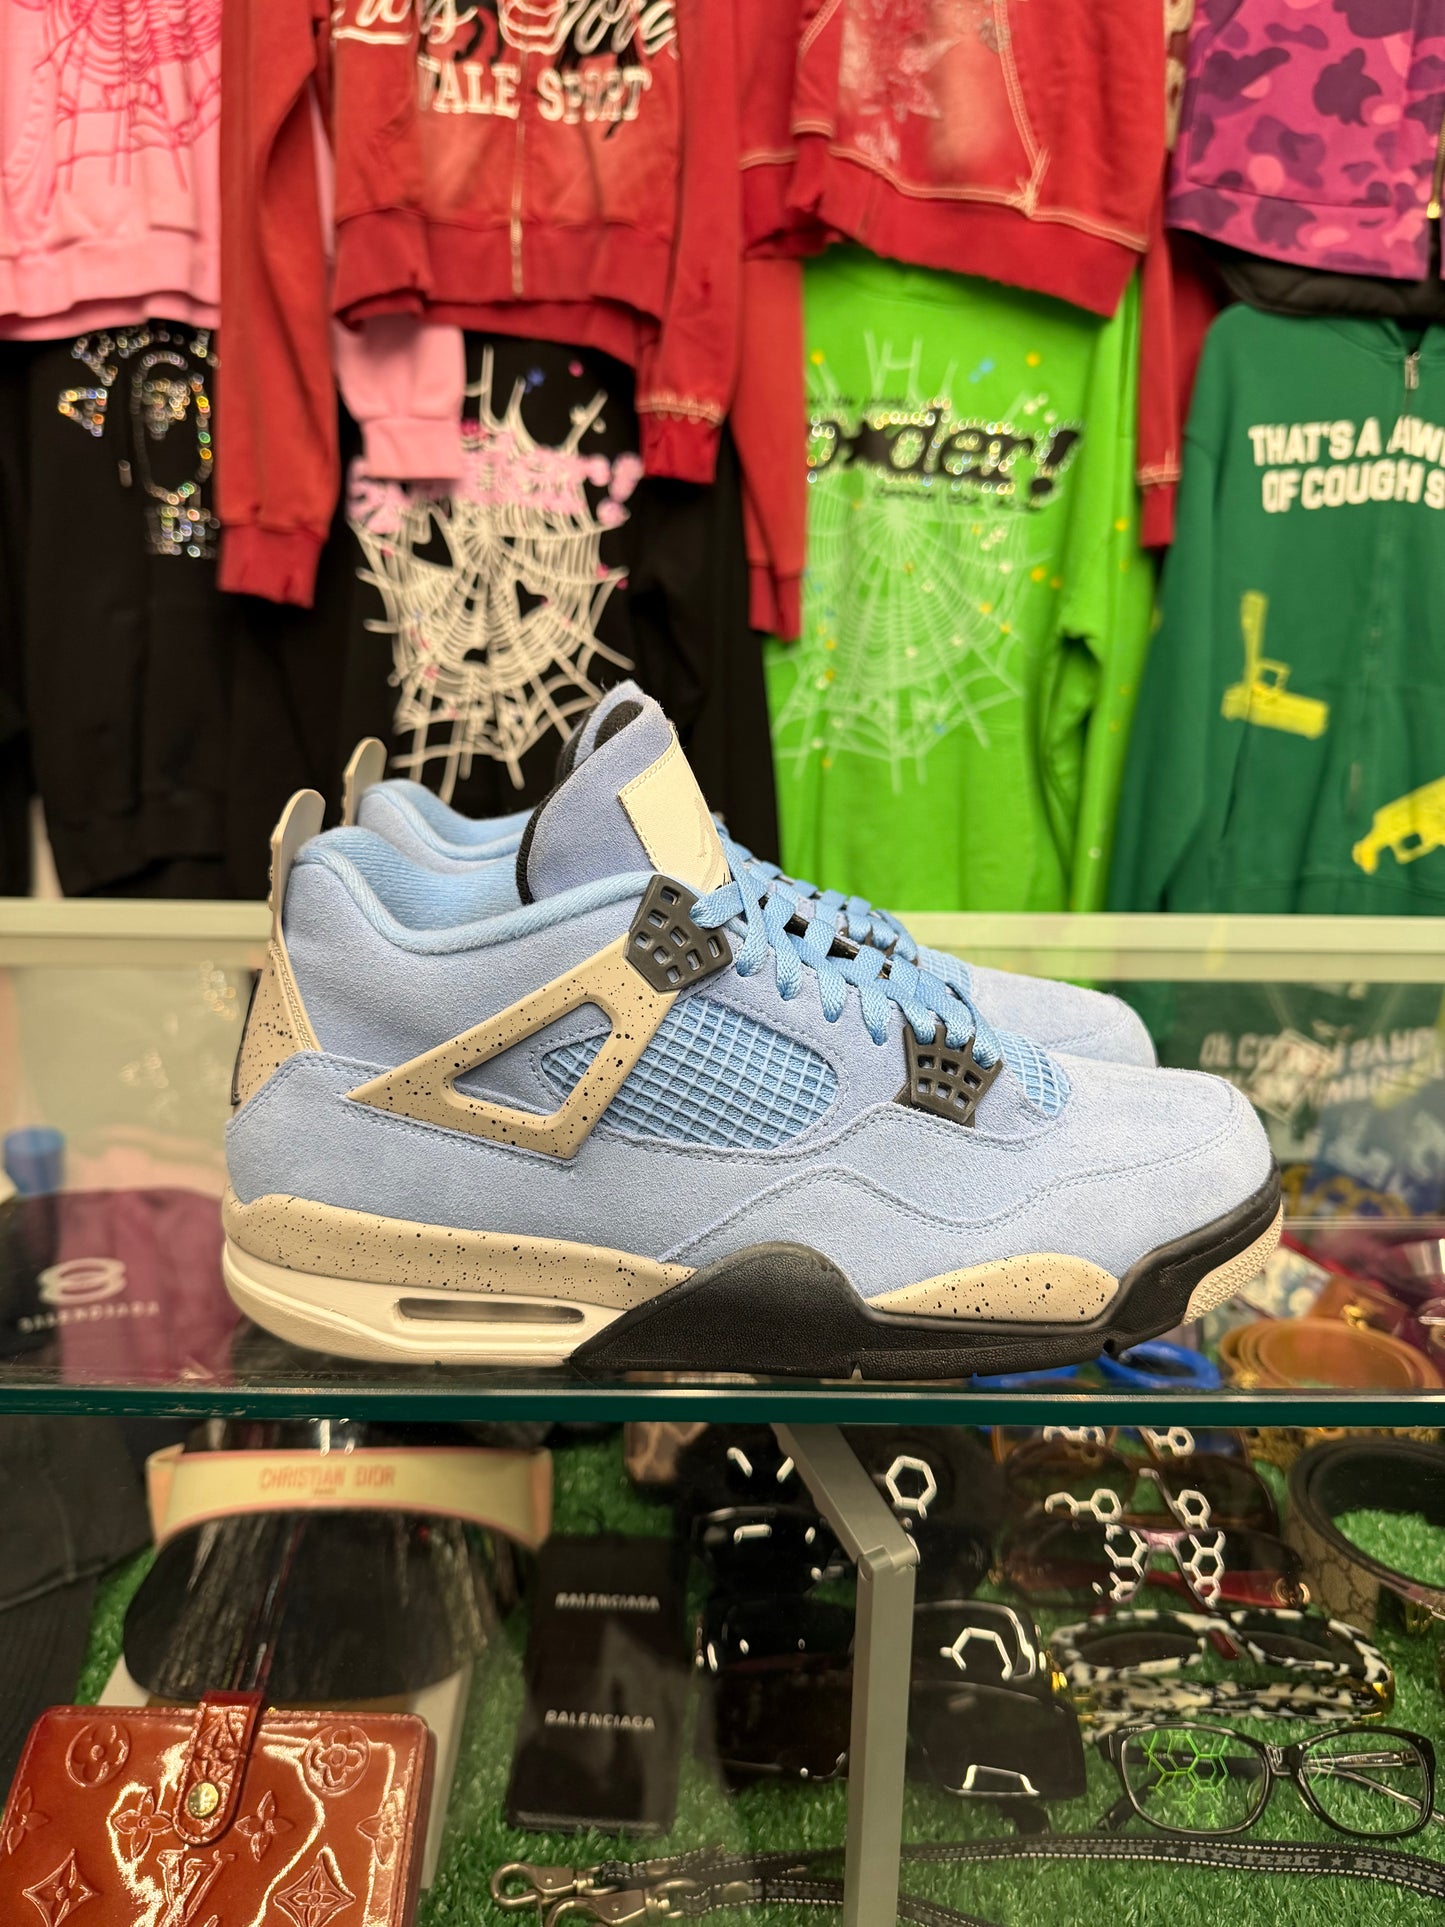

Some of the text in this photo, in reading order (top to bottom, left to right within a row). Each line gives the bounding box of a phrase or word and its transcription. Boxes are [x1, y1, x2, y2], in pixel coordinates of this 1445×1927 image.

[1248, 414, 1445, 468] THAT'S A AW
[1262, 468, 1299, 513] OF
[1302, 459, 1425, 510] COUGH
[259, 1464, 396, 1491] CHRISTIAN DIOR
[555, 1592, 660, 1612] BALENCIAGA
[545, 1709, 655, 1731] BALENCIAGA
[1188, 1843, 1320, 1866] HYSTERIC
